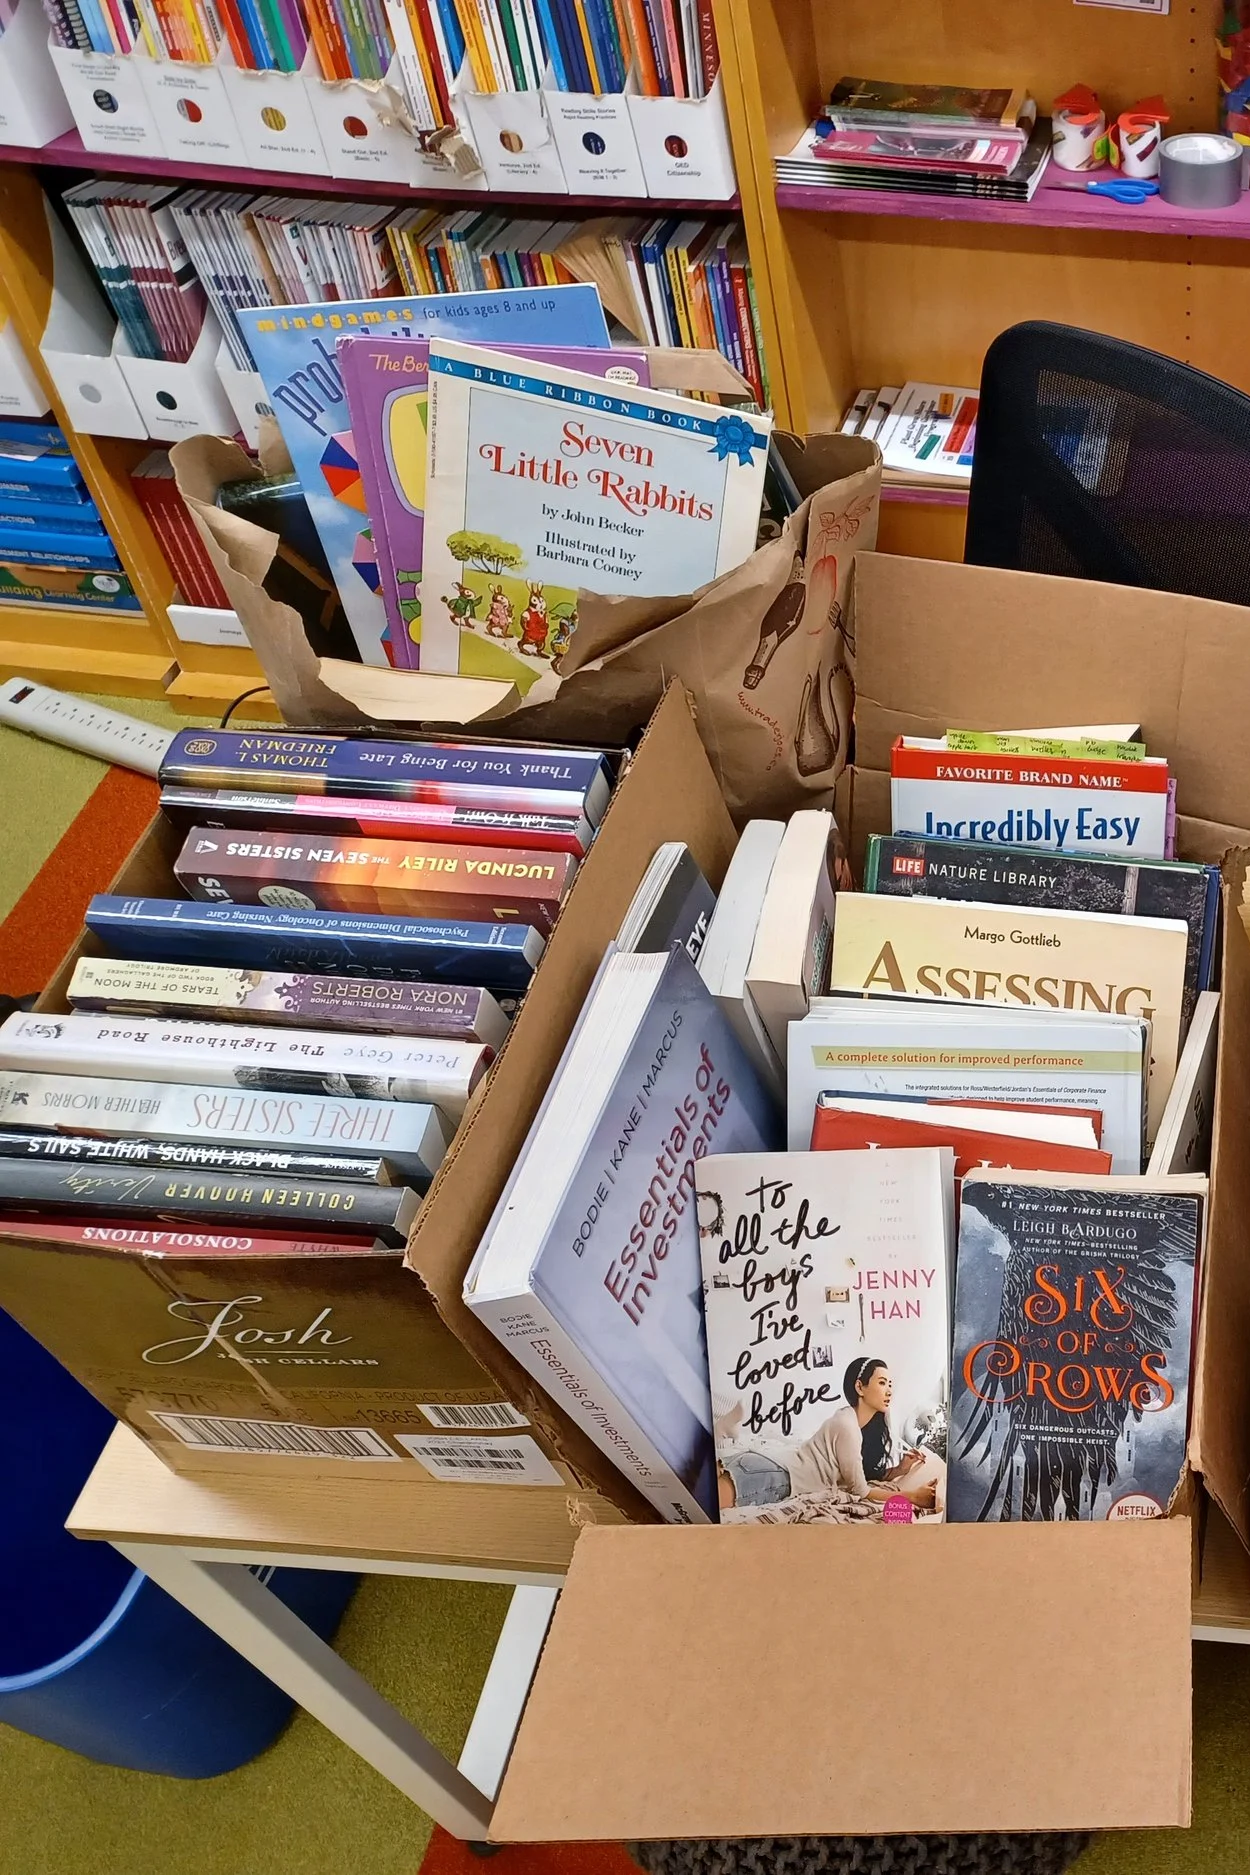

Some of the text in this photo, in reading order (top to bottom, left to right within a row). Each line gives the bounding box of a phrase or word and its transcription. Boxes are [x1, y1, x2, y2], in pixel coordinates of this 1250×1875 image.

[423, 307, 440, 320] for
[445, 304, 469, 319] kids
[474, 304, 499, 320] ages
[503, 300, 510, 312] 8
[515, 300, 536, 312] and
[541, 298, 556, 314] up
[444, 362, 703, 430] A BLUE RIBBON BOOK
[560, 421, 655, 468] Seven
[479, 443, 714, 522] Little Rabbits
[541, 504, 645, 538] by John Becker
[536, 545, 643, 581] Barbara Cooney
[235, 751, 328, 768] THOMAS L.
[239, 738, 337, 755] FRIEDMAN
[359, 752, 573, 779] Thank You for Being Late
[936, 765, 1015, 782] FAVORITE
[1019, 770, 1073, 786] BRAND
[926, 806, 1141, 847] Incredibly Easy
[226, 842, 555, 880] LUCINDA RILEY THE SEVEN SISTERS
[894, 857, 1058, 890] LIFE NATURE LIBRARY
[206, 909, 470, 938] Psychosocial Dimensions of Oncology Nursing Care
[964, 925, 1062, 949] Margo Gottlieb
[94, 978, 220, 996] TEARS OF THE MOON
[312, 981, 468, 1006] NORA ROBERTS
[863, 940, 1157, 1016] ASSESSING
[97, 1028, 461, 1069] Peter Geye The Lighthouse Road
[825, 1051, 1084, 1068] A complete solution for improved performance
[42, 1091, 395, 1143] THREE SISTERS HEATHER MORRIS
[571, 1009, 684, 1259] BODIE KANE MARCUS
[27, 1137, 82, 1155] SAILS
[58, 1163, 356, 1212] COLLEEN HOOVER Verity
[603, 1041, 716, 1304] Essentials of
[622, 1076, 732, 1328] Investments
[745, 1176, 793, 1213] to
[1001, 1201, 1166, 1221] #1 NEW YORK TIMES BESTSELLER
[82, 1226, 253, 1251] CONSOLATIONS
[718, 1198, 841, 1265] all the
[1013, 1220, 1137, 1240] LEIGH BARDUGO
[731, 1253, 814, 1311] boys
[852, 1268, 937, 1291] JENNY
[749, 1300, 804, 1347] I've
[870, 1299, 922, 1320] HAN
[142, 1295, 352, 1367] Josh
[1056, 1330, 1099, 1356] OF
[727, 1328, 812, 1391] loved
[962, 1339, 1176, 1414] CROWS
[742, 1381, 841, 1437] before
[1014, 1423, 1028, 1432] SIX
[1030, 1424, 1075, 1434] DANGEROUS
[1117, 1504, 1156, 1518] NETFLIX
